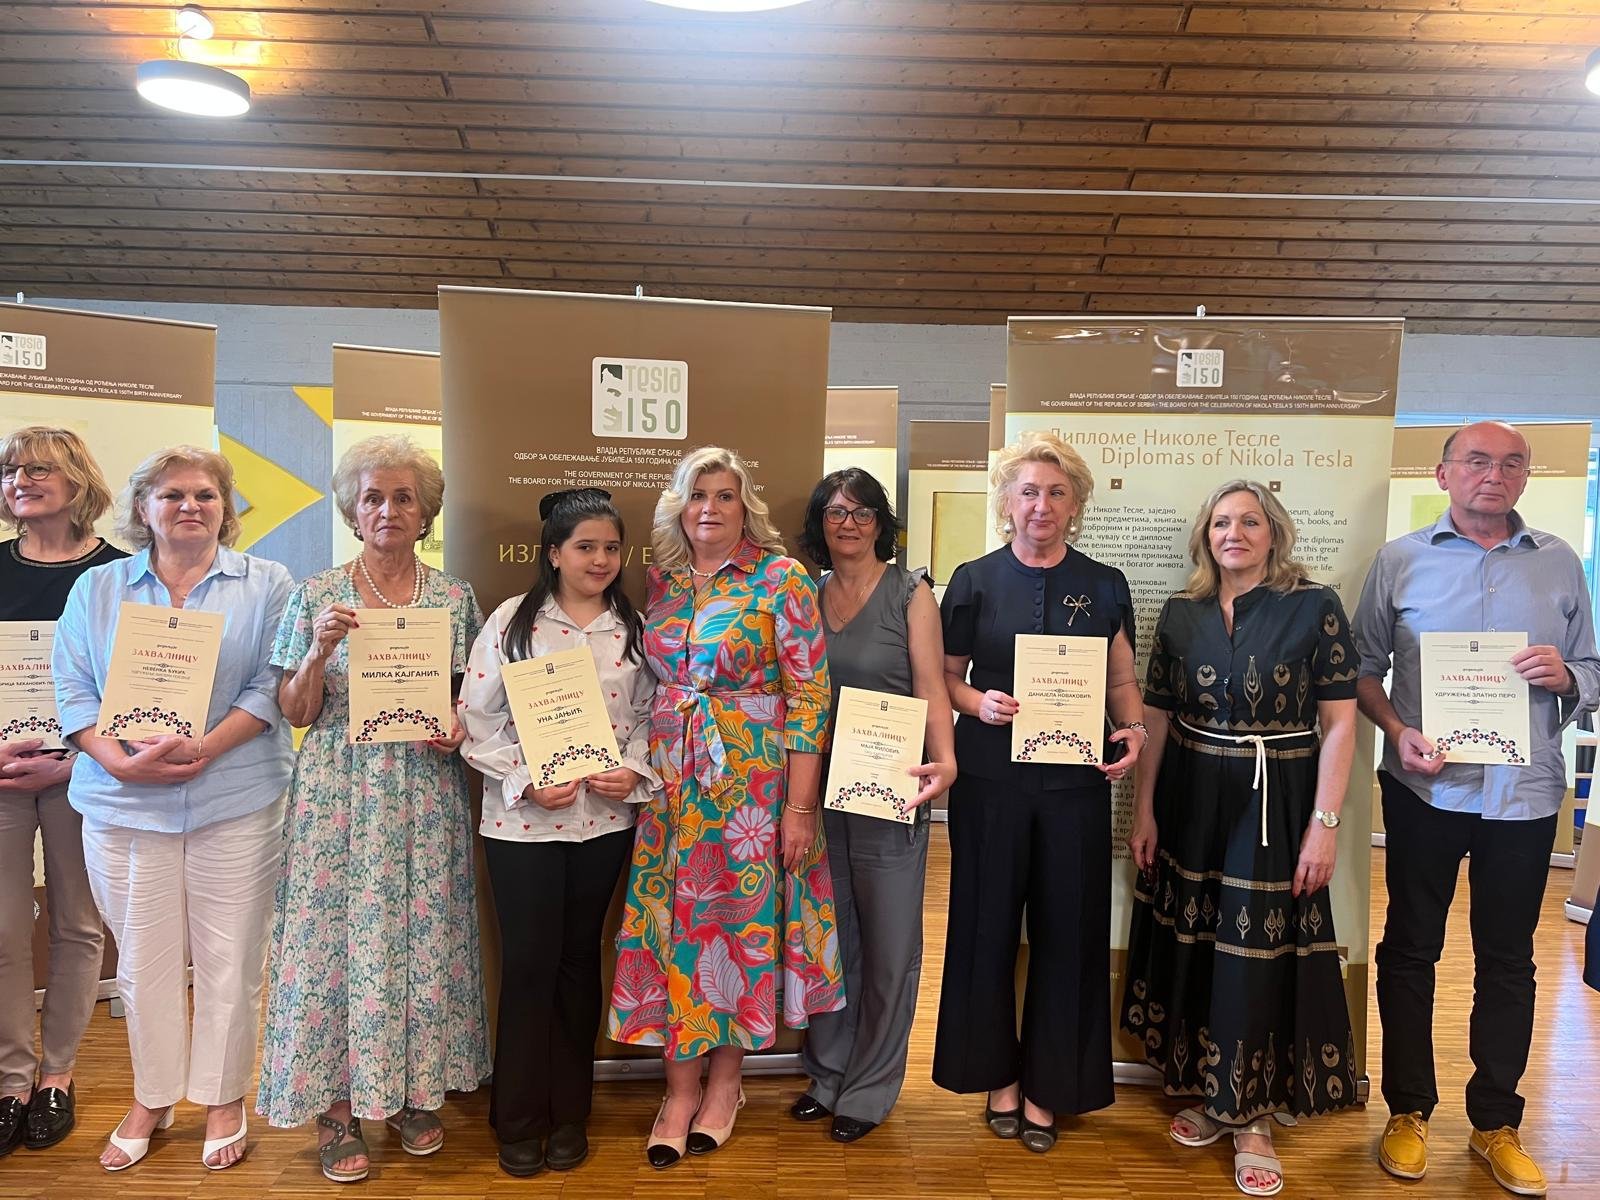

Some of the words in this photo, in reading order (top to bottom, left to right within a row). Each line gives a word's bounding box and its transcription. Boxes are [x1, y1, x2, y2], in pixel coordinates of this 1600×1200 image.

[15, 350, 42, 367] 150
[1193, 367, 1220, 385] 150
[627, 397, 682, 434] 150
[1144, 428, 1217, 447] Николе
[1224, 429, 1280, 447] Тесле
[596, 446, 618, 455] ВЛАДА
[619, 447, 656, 456] РЕПУБЛИКЕ
[657, 449, 682, 457] СРБИЈЕ
[514, 452, 538, 460] ОДБОР
[538, 453, 547, 461] ЗА
[548, 453, 600, 463] ОБЕЛЕЖАВАЊЕ
[600, 455, 633, 464] ЈУБИЛЕЈА
[634, 456, 645, 464] 150
[645, 457, 672, 466] ГОДИНА
[743, 460, 759, 468] ЕСЛЕ
[1102, 447, 1195, 469] Diplomas
[1201, 448, 1223, 467] of
[1230, 449, 1295, 468] Nikola
[1303, 449, 1353, 468] Tesla
[564, 470, 577, 478] THE
[578, 470, 623, 479] GOVERNMENT
[635, 472, 647, 480] THE
[508, 476, 521, 484] THE
[523, 477, 547, 485] BOARD
[547, 478, 561, 486] FOR
[563, 478, 576, 486] THE
[576, 479, 621, 488] CELEBRATION
[632, 481, 656, 489] NIKOLA
[1093, 506, 1121, 514] Николе
[1123, 506, 1146, 515] Тесле,
[1148, 507, 1176, 515] заједно
[1313, 508, 1334, 517] along
[1103, 516, 1152, 524] предметима,
[1307, 518, 1331, 526] books,
[1333, 518, 1348, 526] and
[1311, 535, 1345, 545] diplomas
[1303, 545, 1317, 553] this
[1319, 546, 1339, 554] great
[1095, 552, 1140, 560] различитим
[1320, 563, 1336, 571] life.
[132, 648, 200, 664] ЗАХВАЛНИЦУ
[367, 652, 432, 661] ЗАХВАЛНИЦУ
[0, 663, 52, 671] ЗАХВАЛНИ
[361, 671, 393, 679] МИЛКА
[394, 669, 440, 678] КАЈГАНИЋ
[1439, 673, 1508, 683] ЗАХВАЛНИЦУ
[1031, 677, 1089, 687] ЗАХВАЛНИЦУ
[528, 689, 585, 710] ЗАХВАЛНИЦУ
[536, 713, 553, 724] УНА
[554, 707, 583, 720] ЈАЊИЋ
[851, 727, 908, 743] ЗАХВАЛНИЦУ
